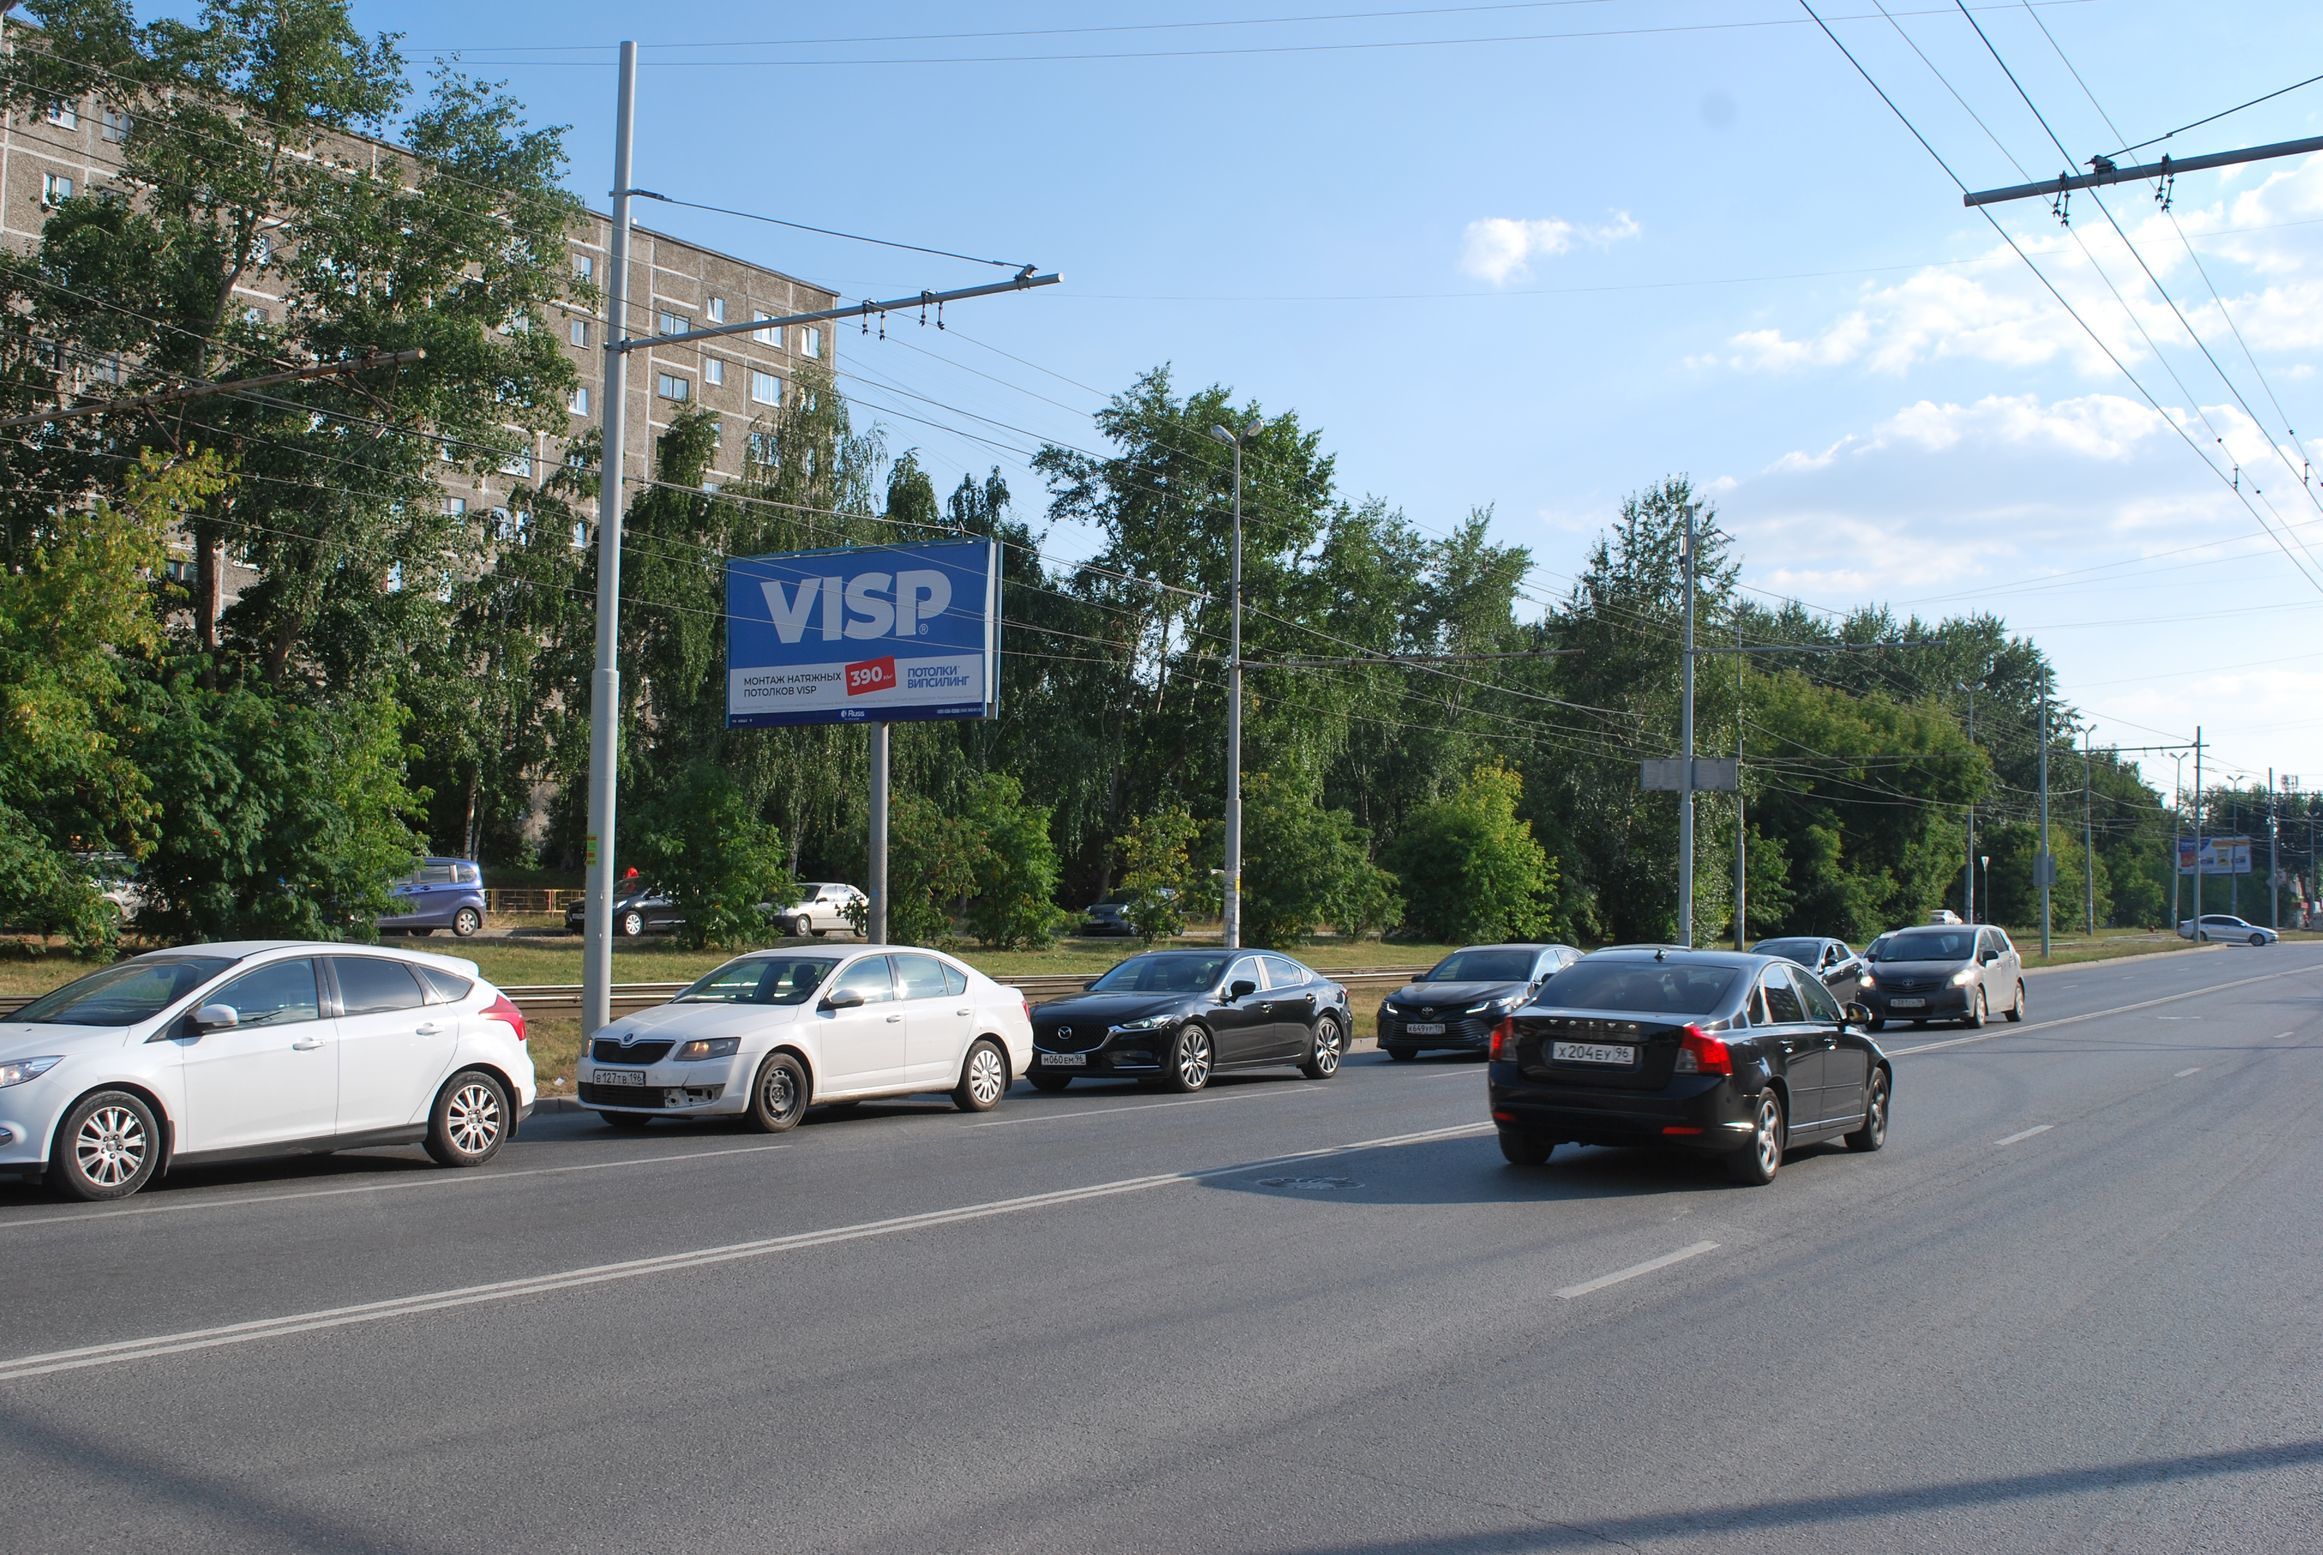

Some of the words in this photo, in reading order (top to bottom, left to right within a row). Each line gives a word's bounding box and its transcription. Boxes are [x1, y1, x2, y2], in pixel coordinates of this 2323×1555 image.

[760, 569, 952, 644] VISP
[850, 665, 883, 687] 390
[908, 665, 958, 678] ПОТОЛКИ
[744, 676, 785, 687] МОНТАЖ
[788, 672, 842, 685] НАТЯЖНЫХ
[908, 676, 970, 689] ВИПСИЛИНГ
[744, 686, 795, 698] ПОТОЛКОВ
[797, 685, 817, 695] VISP
[848, 710, 865, 718] Russ
